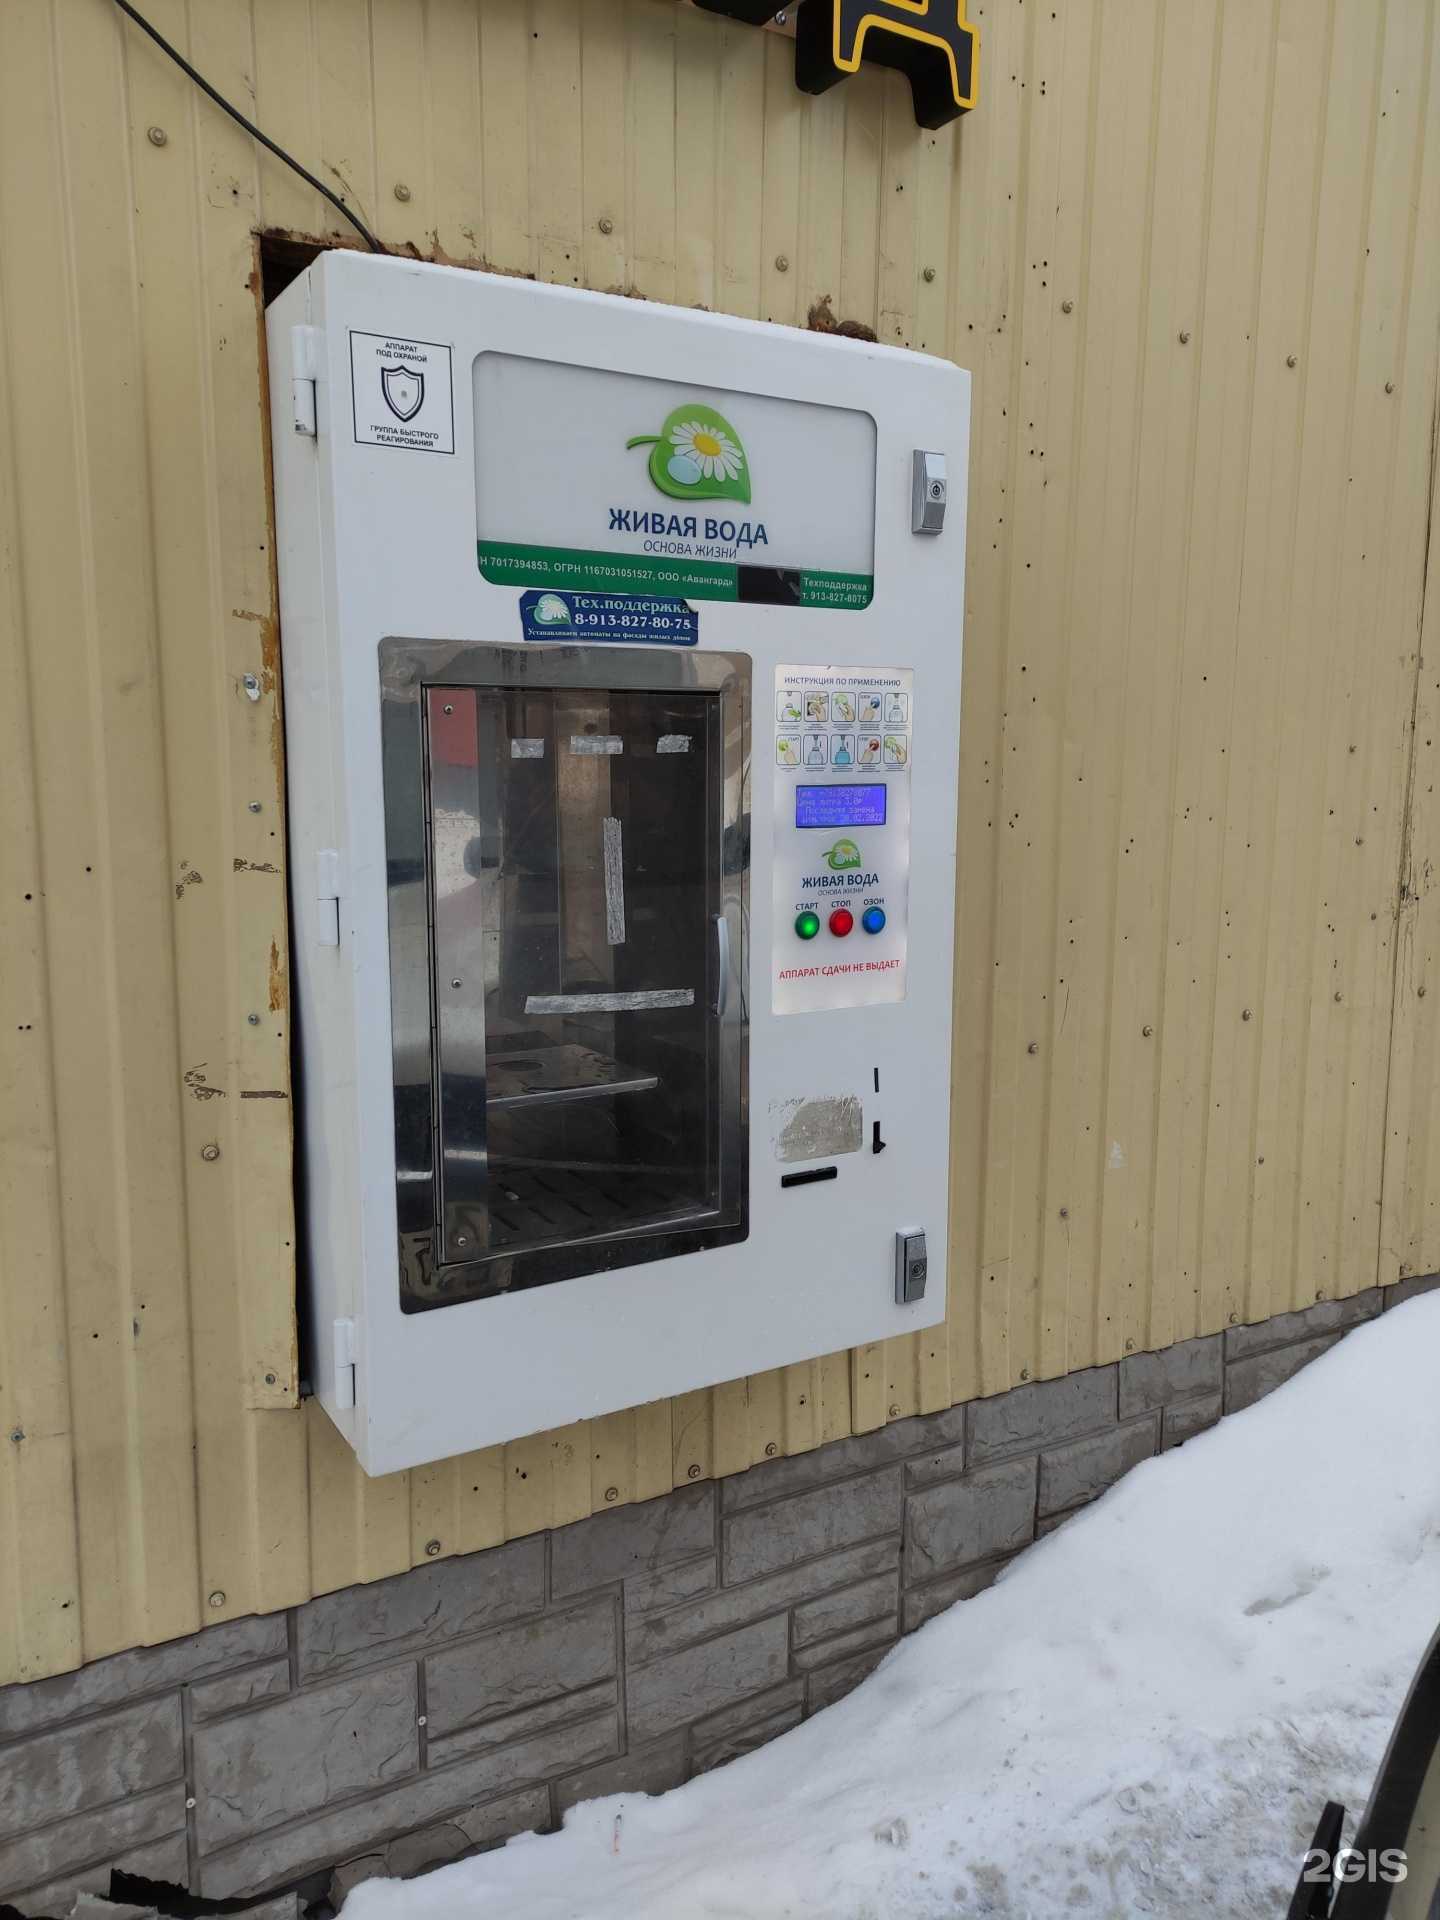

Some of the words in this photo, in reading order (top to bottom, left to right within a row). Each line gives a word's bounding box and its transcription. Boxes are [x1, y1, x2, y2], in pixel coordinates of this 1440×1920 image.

[385, 342, 417, 353] АППАРАТ
[376, 349, 392, 359] ПОД
[393, 352, 428, 363] ОХРАНОЙ
[370, 425, 398, 434] ГРУППА
[400, 428, 439, 440] БЫСТРОГО
[377, 434, 434, 447] РЕАГИРОВАНИЯ
[608, 508, 697, 538] ЖИВАЯ
[704, 518, 768, 549] ВОДА
[643, 539, 692, 555] ОСНОВА
[695, 544, 737, 559] ЖИЗНИ
[491, 556, 551, 573] 7017394853,
[554, 563, 581, 573] ОГРН
[584, 566, 656, 580] 1167031051527,
[658, 572, 679, 582] ООО
[803, 578, 868, 592] Техподдержка
[572, 595, 690, 615] Тех.поддержка
[574, 613, 691, 630] 8-913-827-80-75
[784, 677, 834, 686] ИНСТРУКЦИЯ
[836, 678, 847, 686] ПО
[848, 678, 901, 687] ПРИМЕНЕНИЮ
[802, 875, 844, 889] ЖИВАЯ
[847, 873, 879, 887] ВОДА
[817, 888, 842, 896] ОСНОВА
[795, 902, 819, 911] СТАРТ
[831, 900, 851, 908] СТОП
[863, 898, 885, 906] ОЗОН
[779, 967, 820, 980] АППАРАТ
[822, 965, 851, 977] СДАЧИ
[853, 963, 864, 972] НЕ
[866, 959, 900, 971] ВЫДАЕТ
